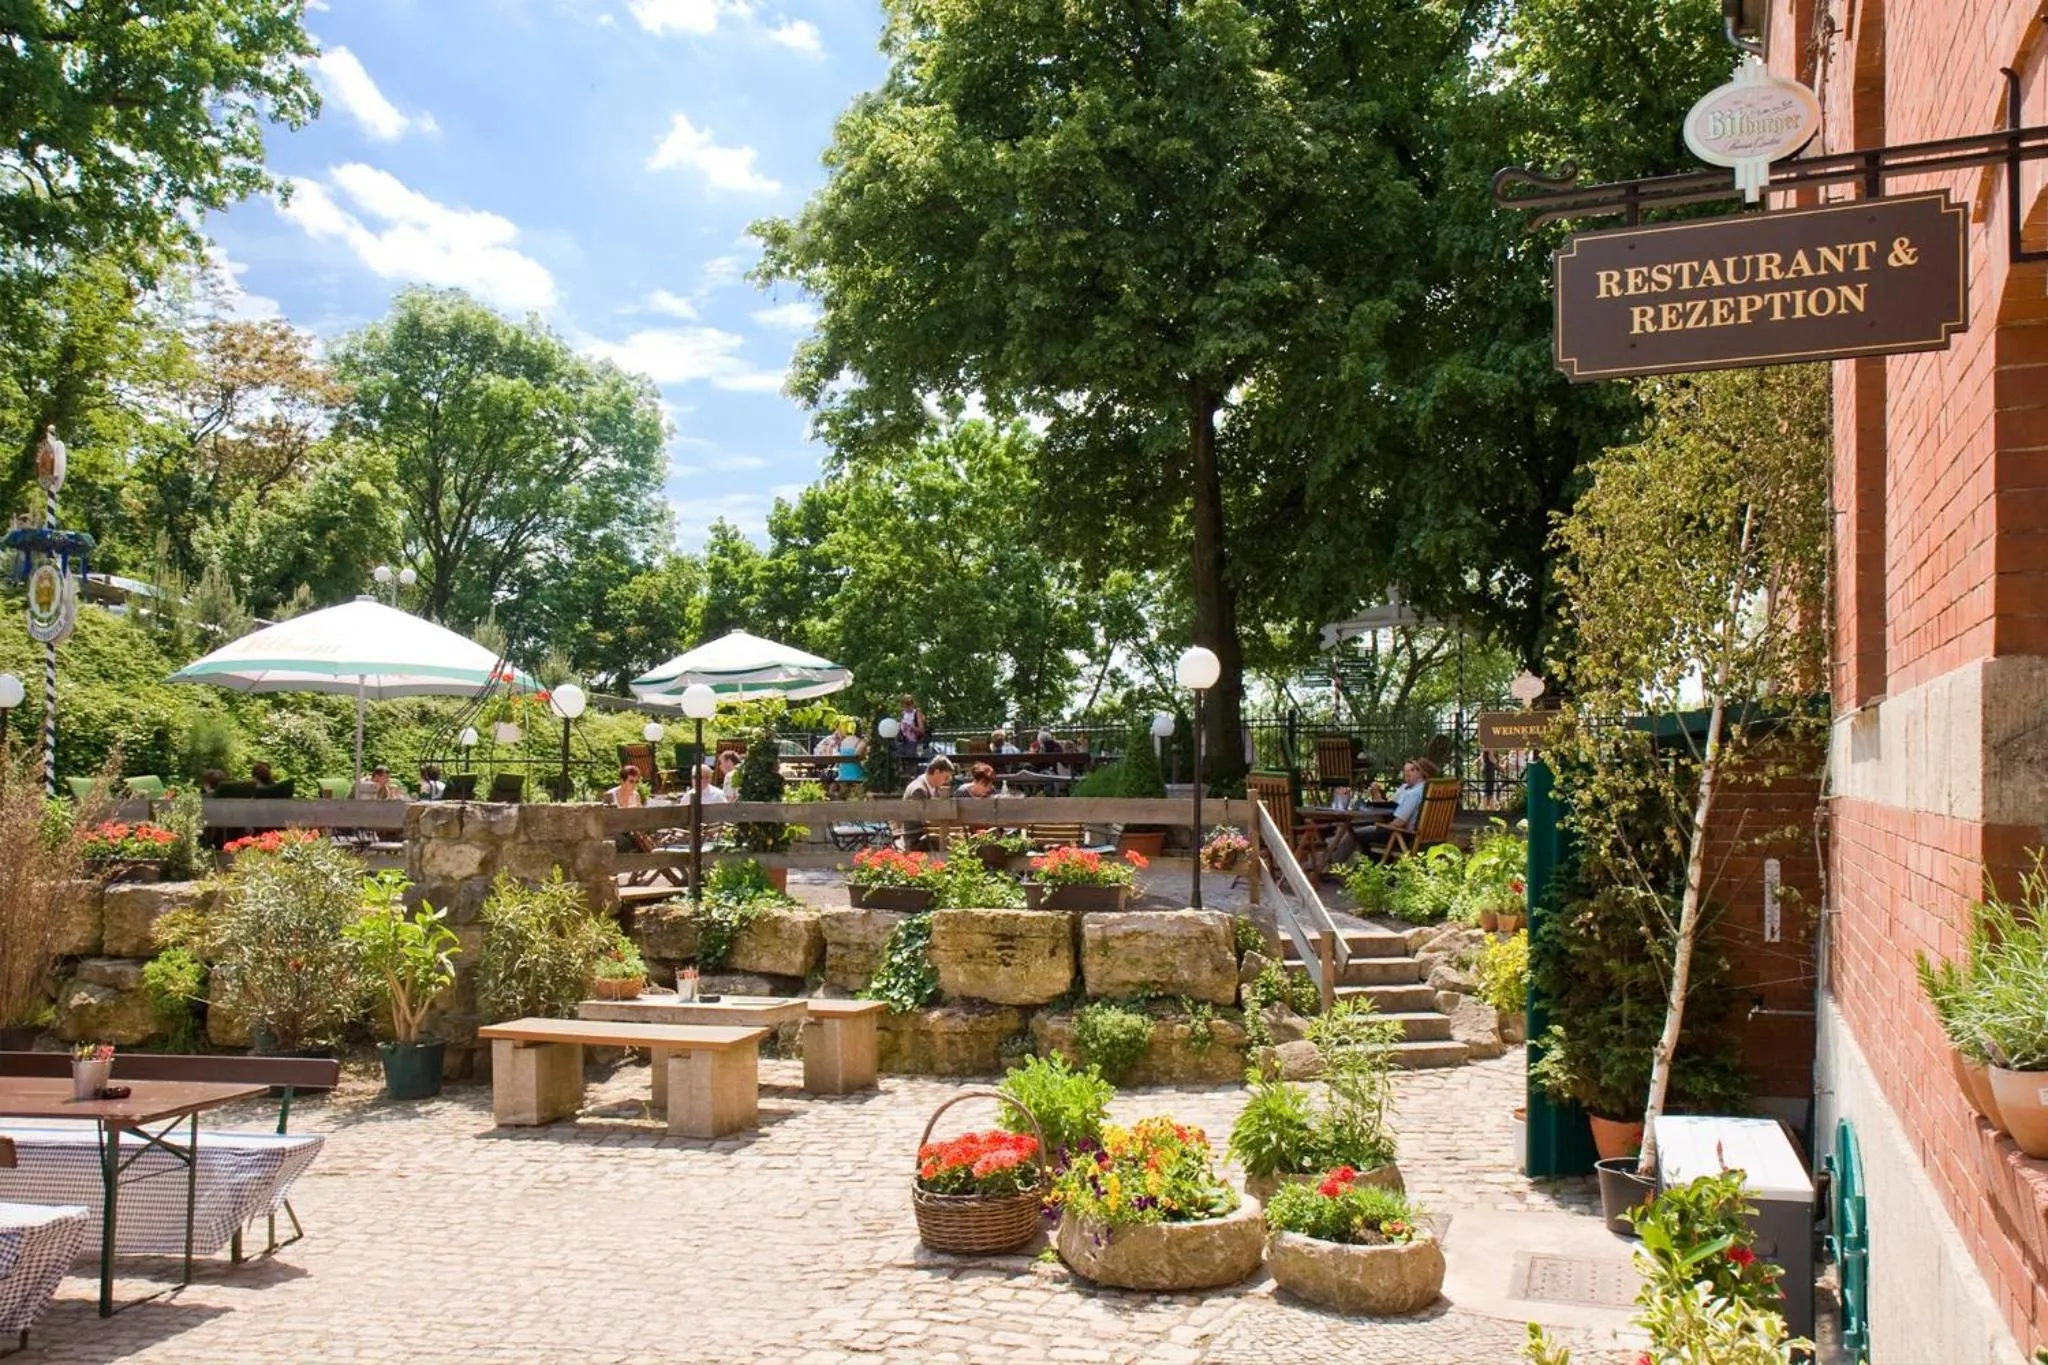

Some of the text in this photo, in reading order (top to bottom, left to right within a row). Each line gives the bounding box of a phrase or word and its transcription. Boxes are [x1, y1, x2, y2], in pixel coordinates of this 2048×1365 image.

[1705, 108, 1801, 140] Bitburger
[1595, 236, 1919, 299] RESTAURANT &
[1629, 283, 1868, 335] REZEPTION
[1491, 725, 1548, 736] WEINKEL
